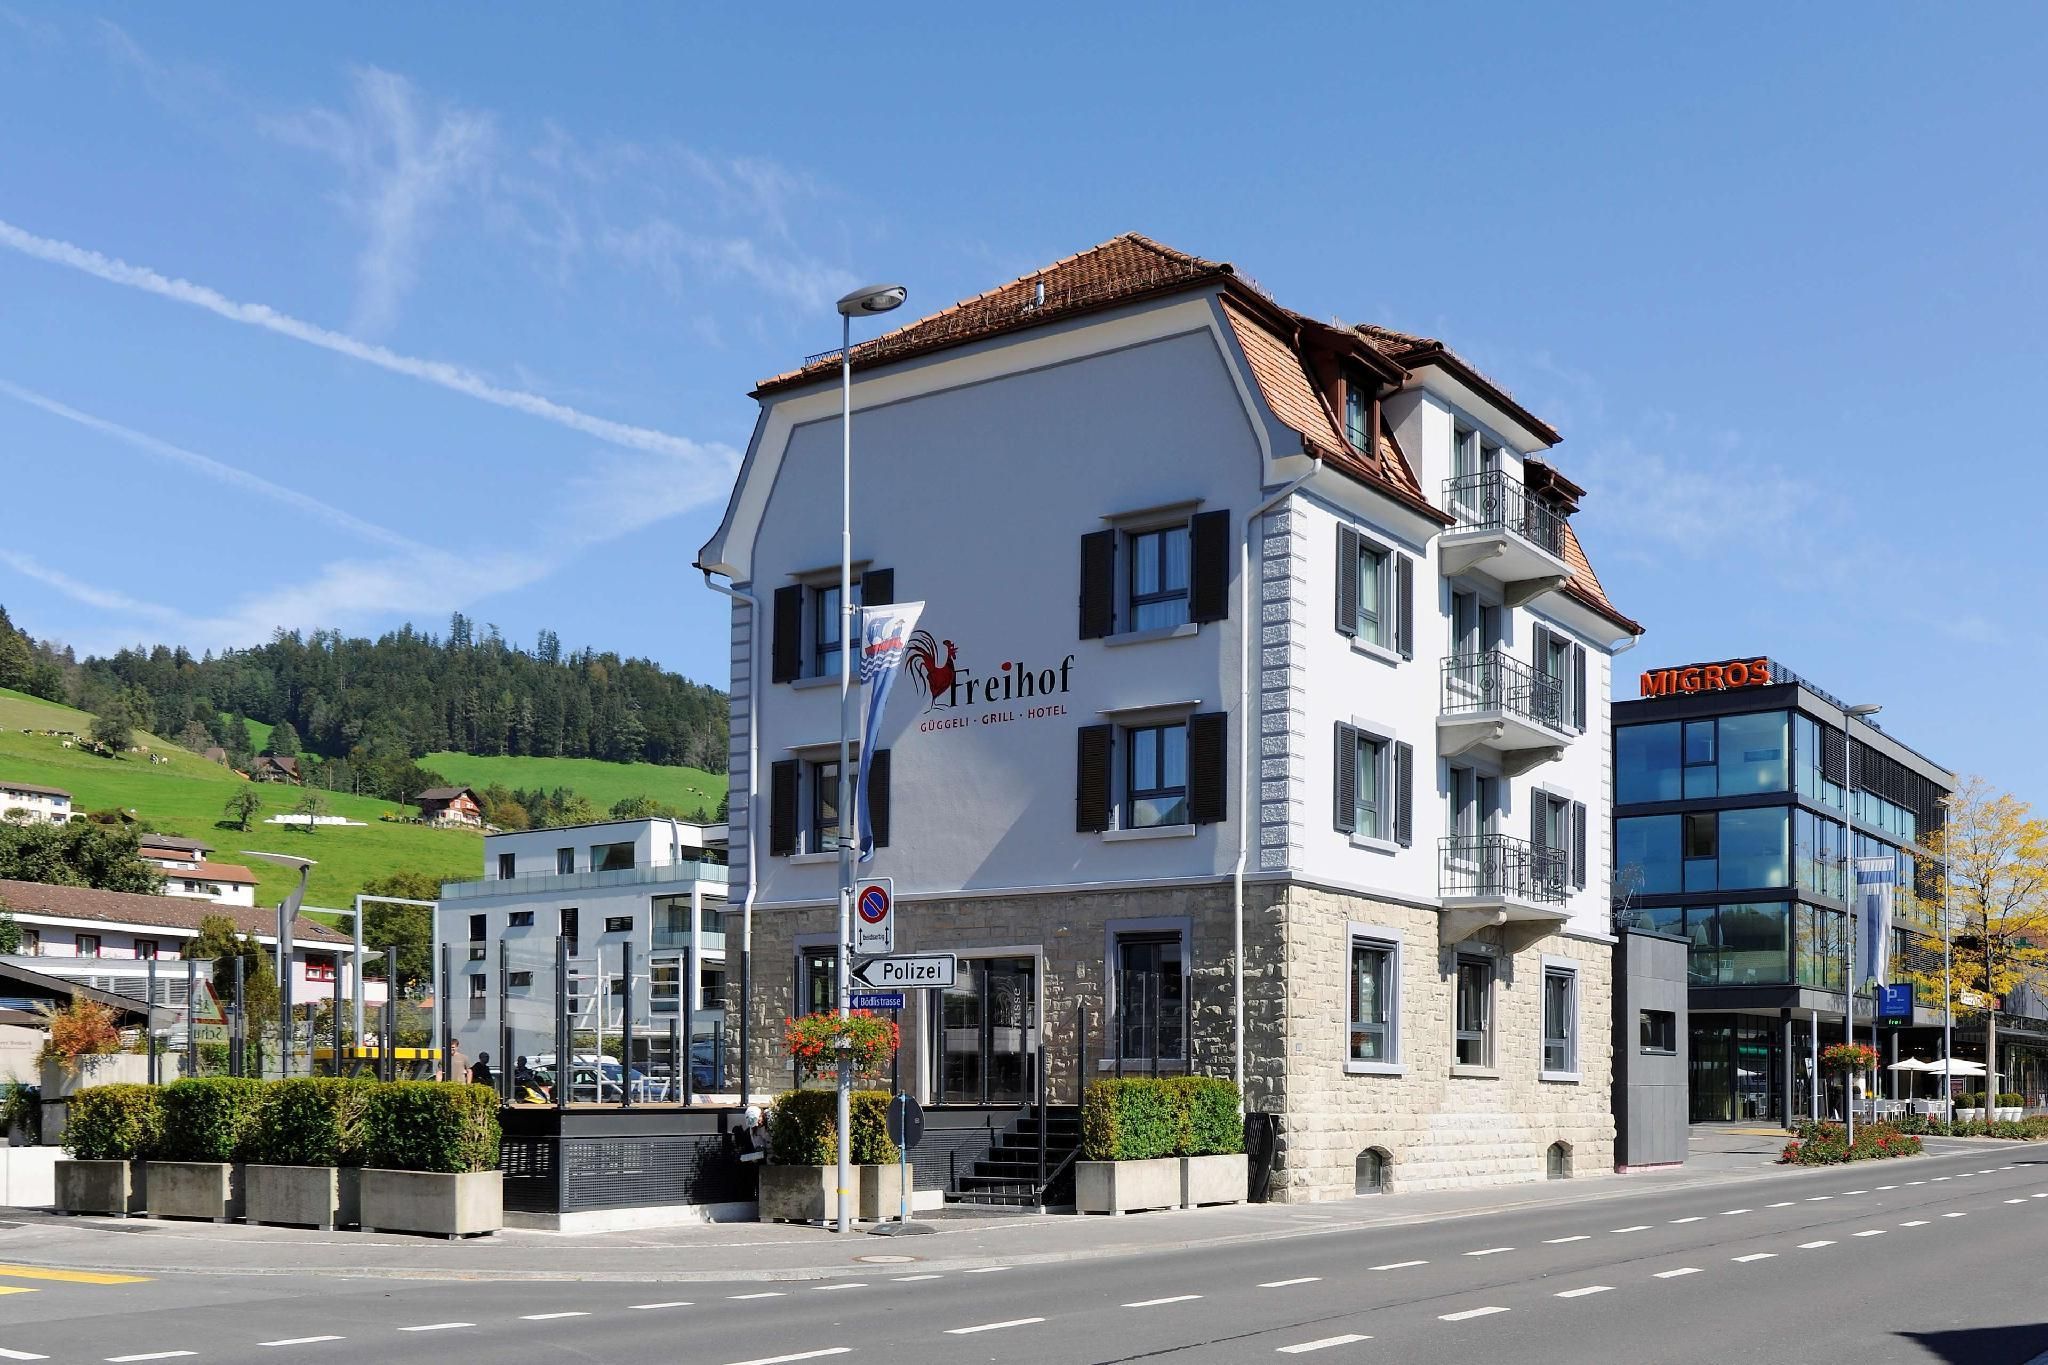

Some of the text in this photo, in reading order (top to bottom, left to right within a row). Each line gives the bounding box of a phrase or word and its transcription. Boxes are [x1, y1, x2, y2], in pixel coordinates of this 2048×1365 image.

[951, 655, 1074, 707] Freihof
[1640, 660, 1770, 697] MIGROS
[920, 705, 1067, 732] GÜGGELI GRILL HOTEL
[884, 962, 940, 980] Polizei
